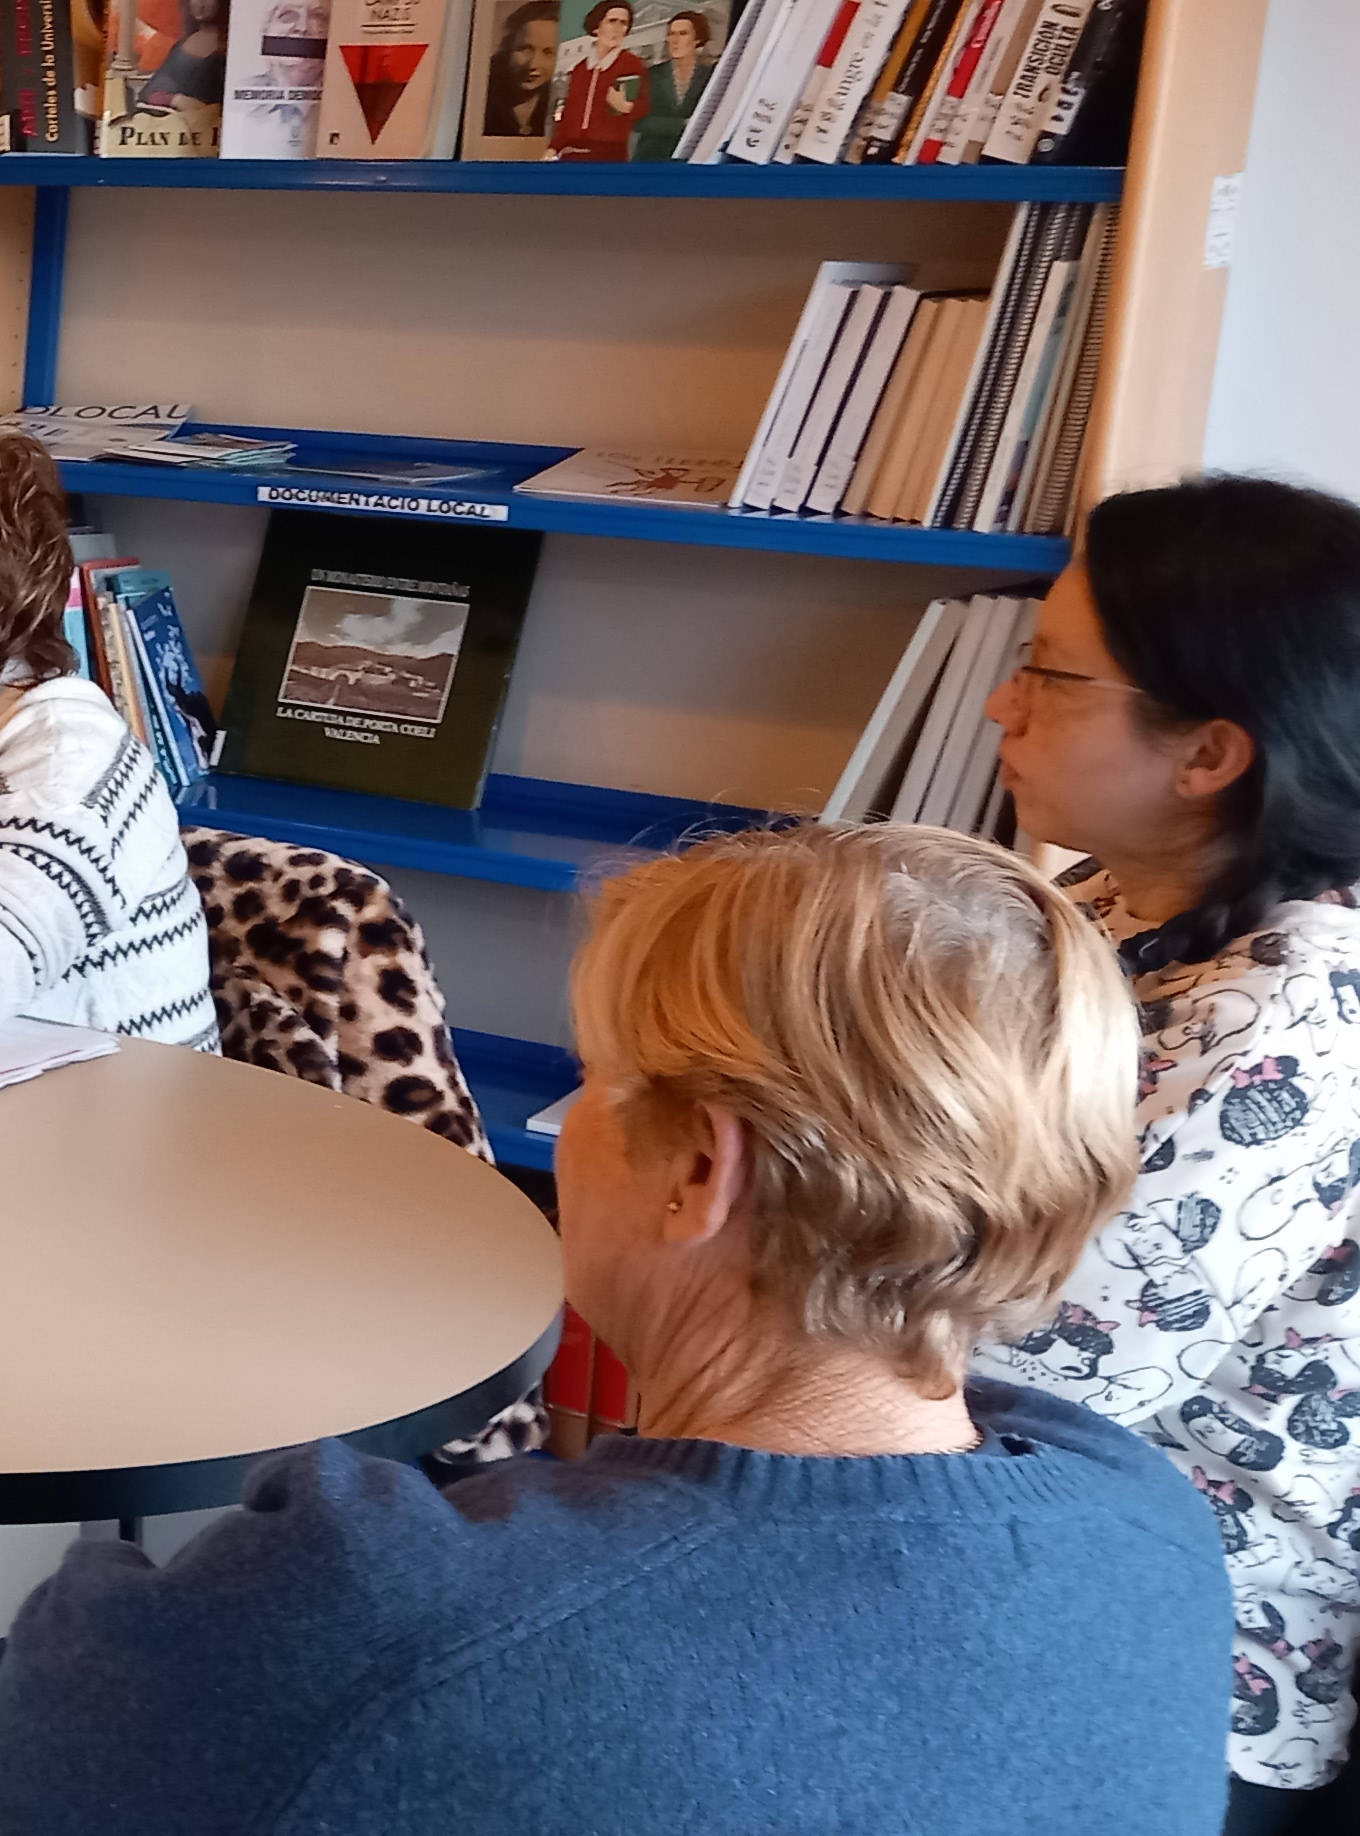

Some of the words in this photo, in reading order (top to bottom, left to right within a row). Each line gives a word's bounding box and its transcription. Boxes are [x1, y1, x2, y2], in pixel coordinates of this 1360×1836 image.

[1045, 26, 1080, 76] OCULTA
[41, 54, 56, 67] la
[41, 70, 56, 86] de
[118, 126, 170, 146] PLAN
[426, 500, 491, 518] LOCAL
[276, 706, 293, 719] LA
